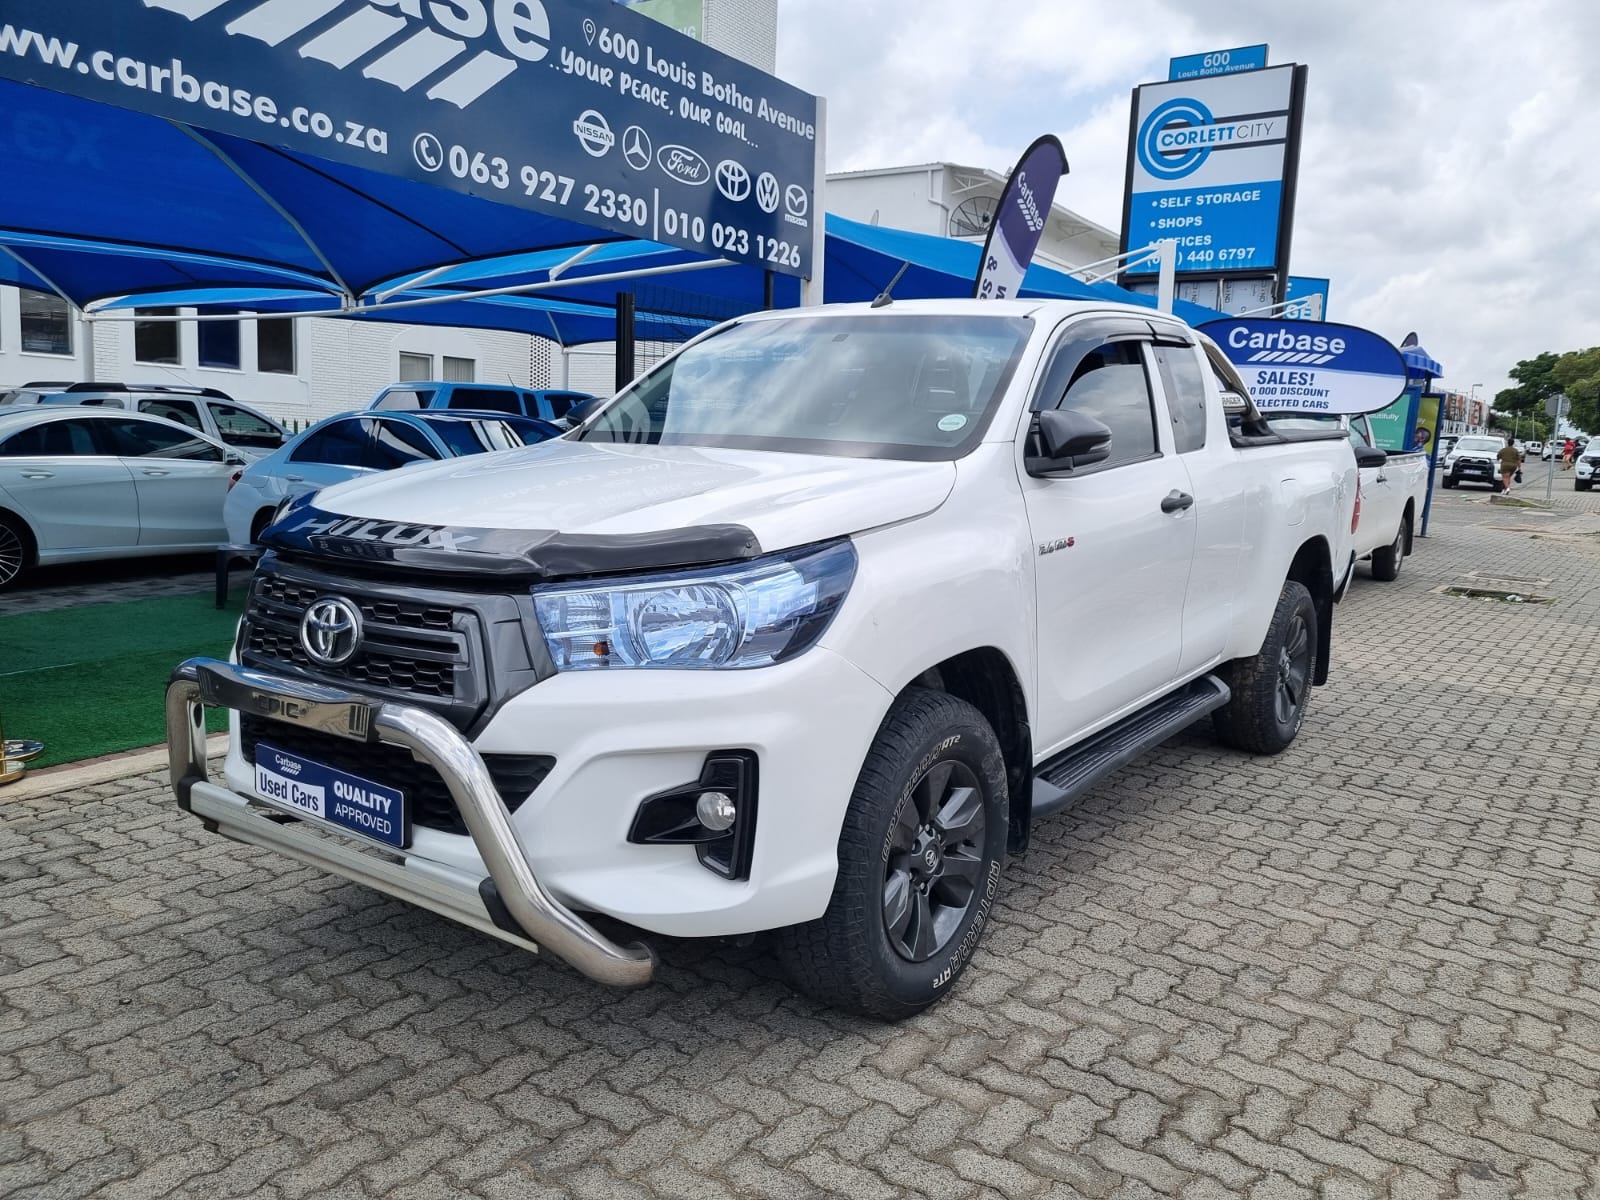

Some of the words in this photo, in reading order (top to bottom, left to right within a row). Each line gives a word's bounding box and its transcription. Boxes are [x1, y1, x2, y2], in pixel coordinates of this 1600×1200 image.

[1203, 52, 1231, 68] 600
[1225, 63, 1255, 72] Avenue
[1178, 69, 1198, 78] Louis
[1200, 66, 1223, 75] Botha
[599, 27, 639, 65] 600
[647, 46, 696, 90] Louis
[702, 71, 752, 114] Botha
[757, 98, 815, 140] Avenue
[679, 97, 711, 126] OUR
[575, 123, 613, 144] NISSAN
[666, 149, 701, 179] Ford
[449, 144, 510, 189] 063
[520, 165, 575, 205] 927
[583, 183, 647, 226] 2330
[664, 208, 705, 243] 010
[711, 222, 749, 255] 023
[756, 235, 801, 268] 1226
[1017, 171, 1044, 230] Carbase
[1159, 196, 1192, 208] SELF
[1196, 190, 1261, 206] STORAGE
[1158, 216, 1202, 229] SHOPS
[1187, 250, 1214, 262] 440
[1218, 247, 1256, 261] 6797
[1228, 326, 1346, 354] Carbase
[1257, 370, 1315, 387] SALES!
[1258, 386, 1277, 396] 000
[1280, 387, 1330, 398] DISCOUNT
[1302, 399, 1329, 409] CARS
[288, 517, 479, 553] HILUX
[275, 754, 302, 771] Carbase
[260, 772, 287, 800] Used
[291, 784, 319, 811] Cars
[333, 780, 391, 814] QUALITY
[335, 803, 391, 834] APPROVED
